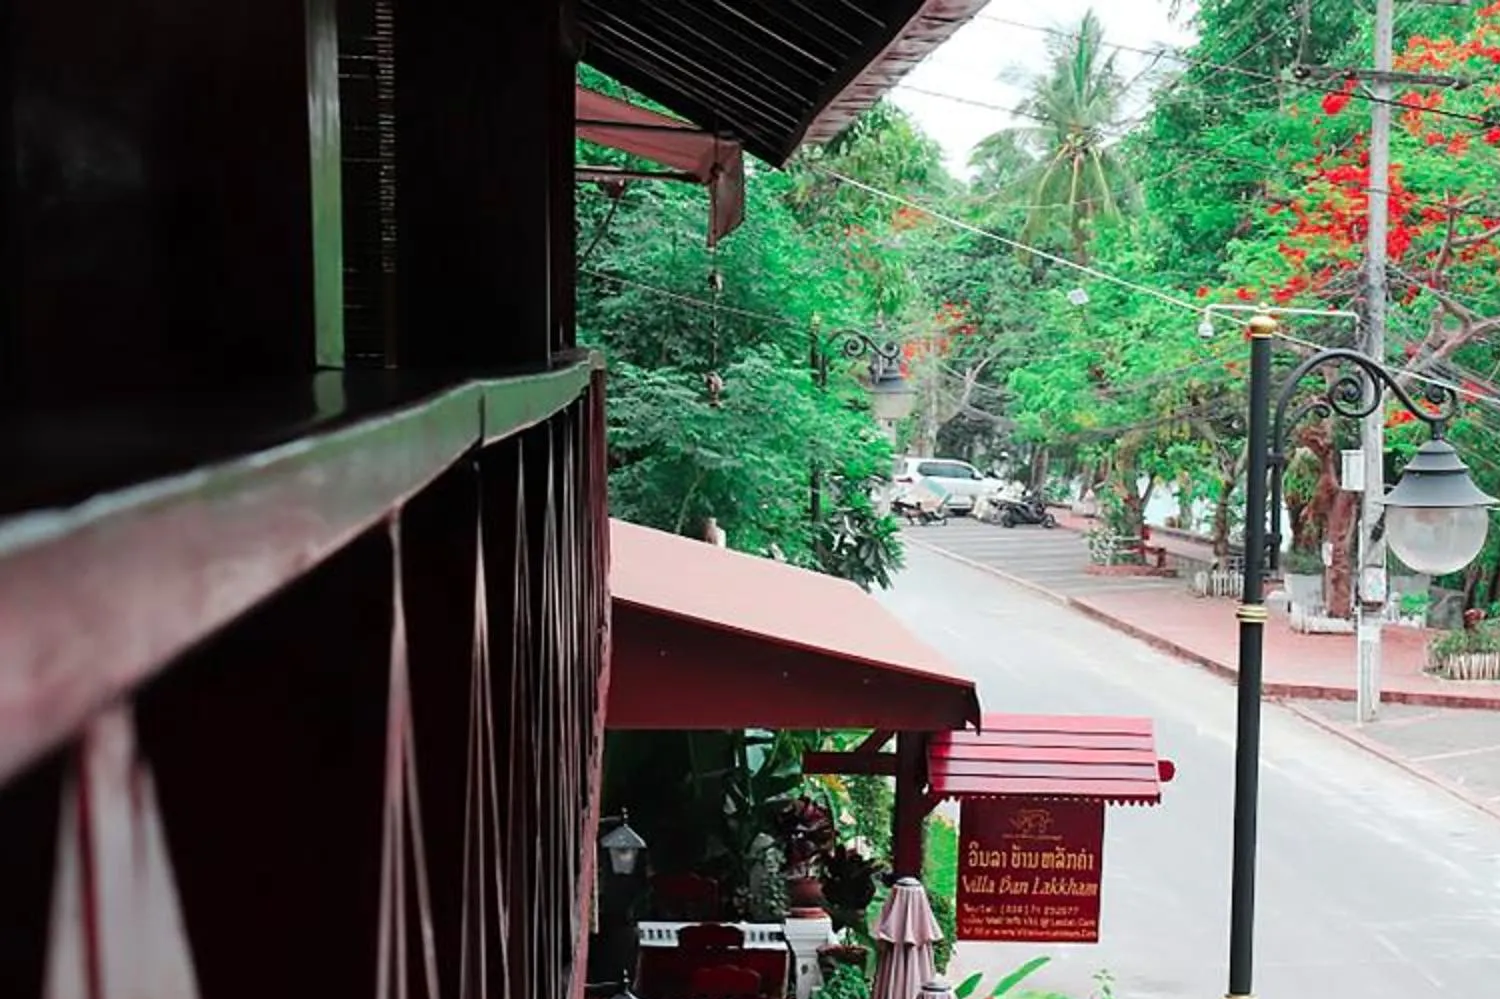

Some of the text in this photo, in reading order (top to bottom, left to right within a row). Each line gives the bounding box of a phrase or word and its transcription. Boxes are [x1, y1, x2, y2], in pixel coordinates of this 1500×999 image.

[962, 874, 1099, 897] Villa Ban Lakkham
